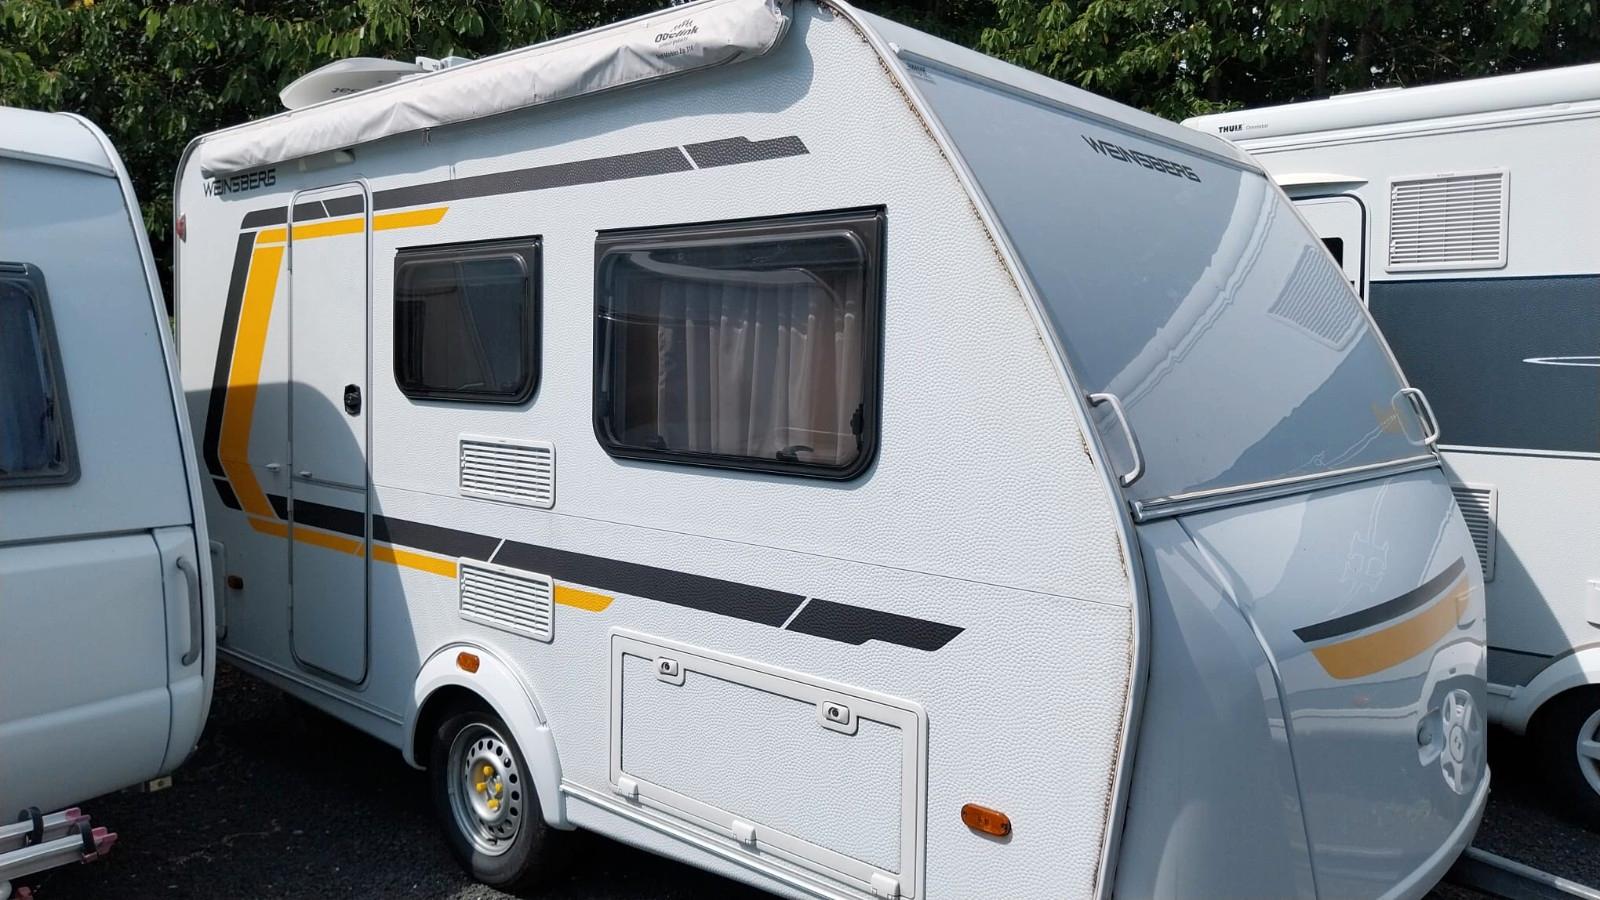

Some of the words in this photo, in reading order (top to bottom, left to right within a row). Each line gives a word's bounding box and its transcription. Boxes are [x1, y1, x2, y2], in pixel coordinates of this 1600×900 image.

[1218, 124, 1242, 133] THULE
[1080, 134, 1201, 183] WEINSBERG
[203, 168, 276, 198] WEINSBERG
